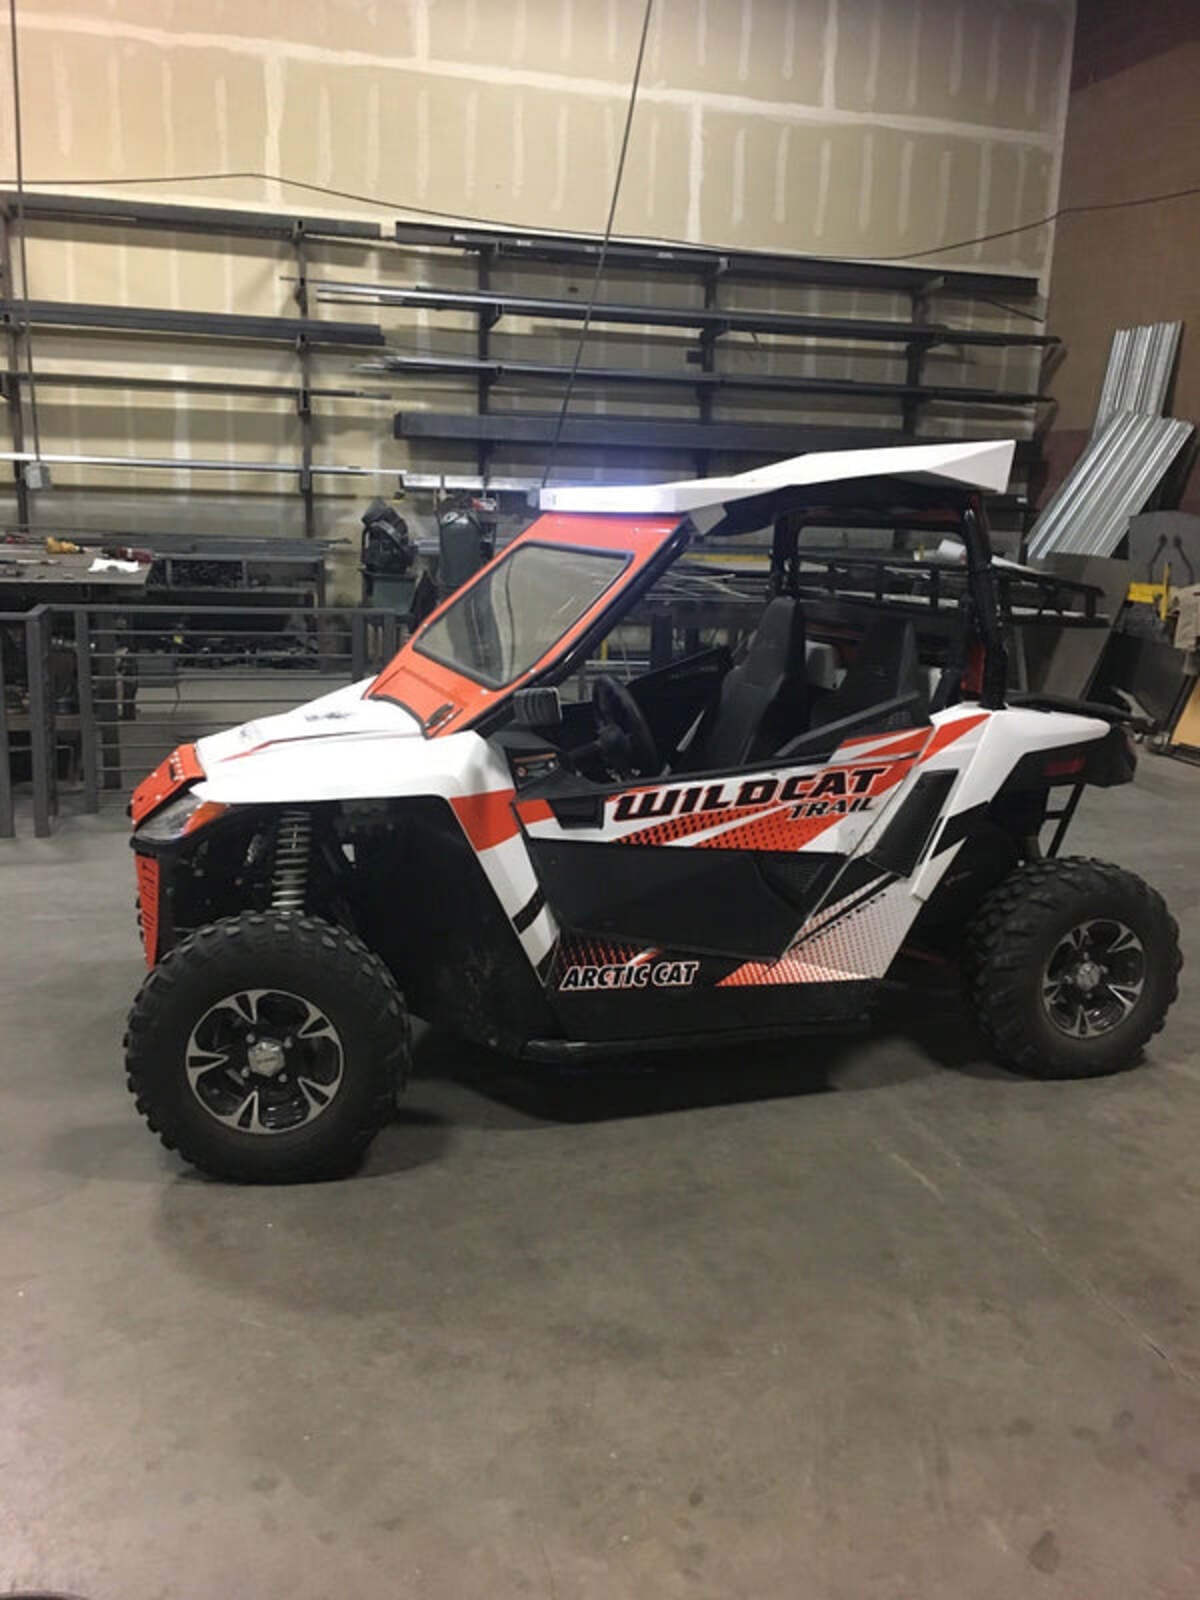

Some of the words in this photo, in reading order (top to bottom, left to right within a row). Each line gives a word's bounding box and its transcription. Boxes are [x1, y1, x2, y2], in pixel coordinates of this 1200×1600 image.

[613, 766, 889, 821] WILDCAT
[788, 797, 876, 819] TRAIL
[561, 964, 651, 991] ARCTIC
[652, 961, 699, 986] CAT
